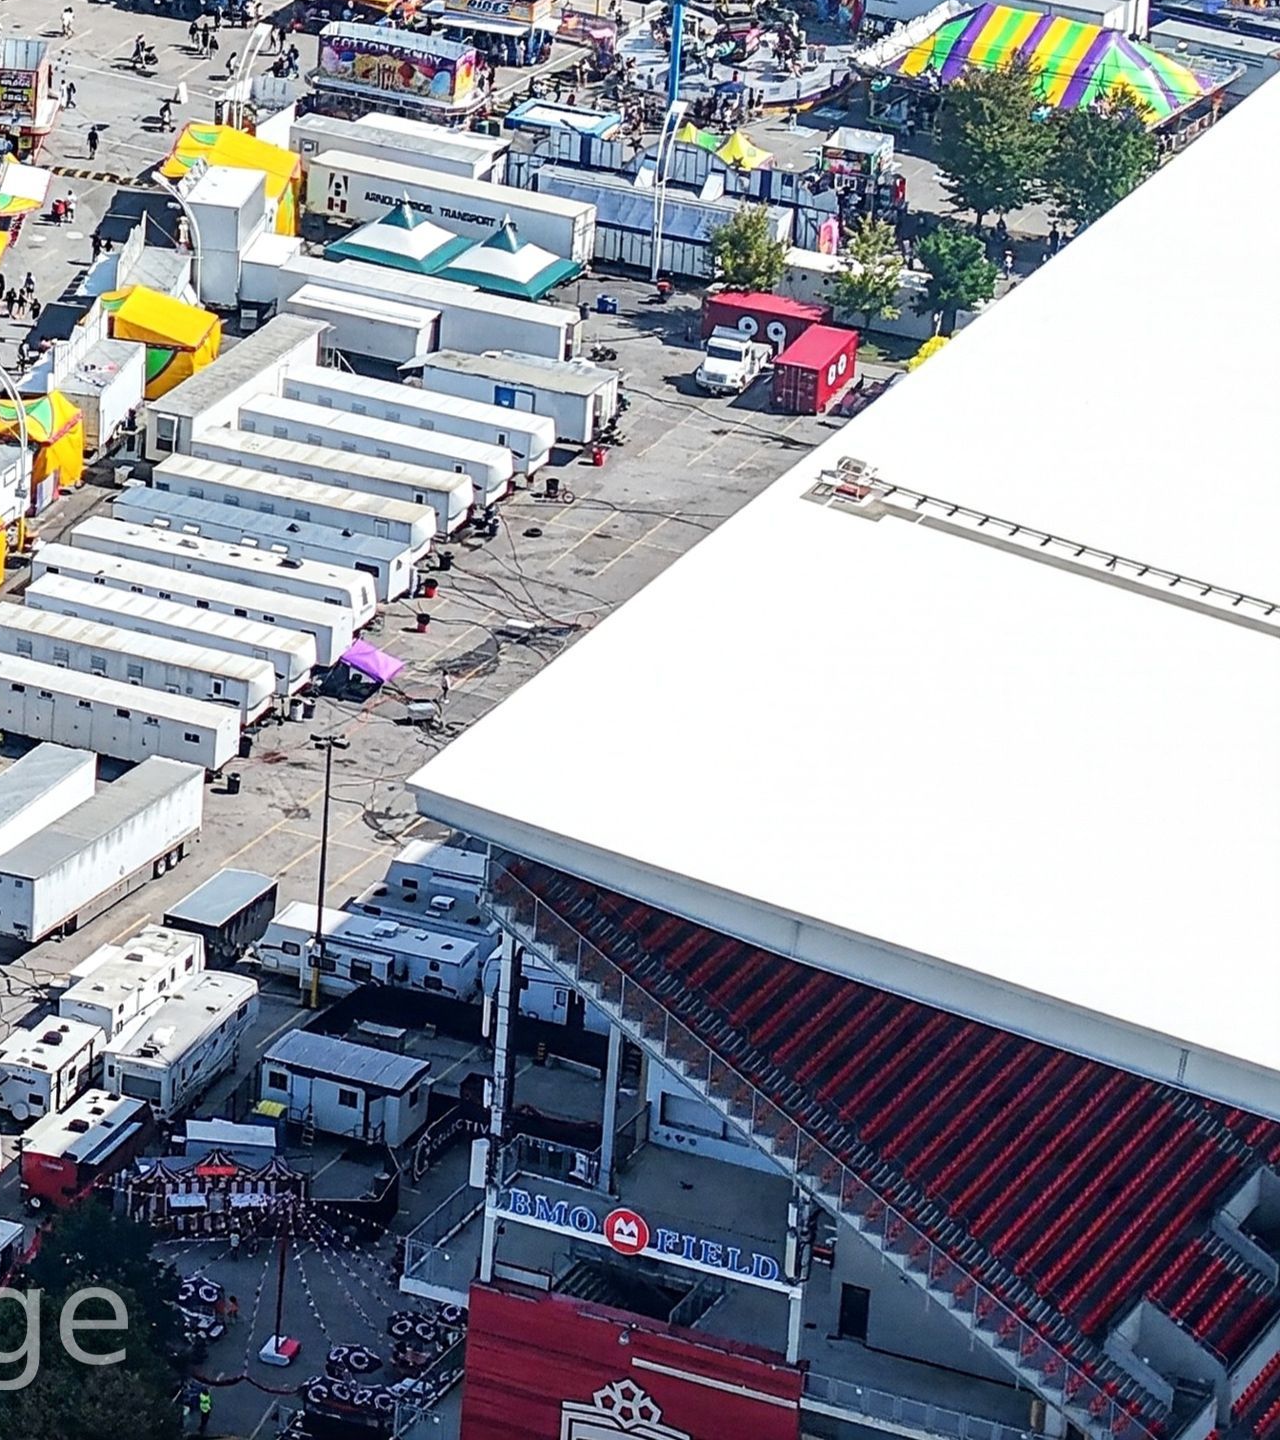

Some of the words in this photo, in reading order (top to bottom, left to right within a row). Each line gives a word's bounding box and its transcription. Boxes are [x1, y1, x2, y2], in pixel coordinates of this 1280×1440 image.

[439, 207, 496, 228] TRANSPORT
[508, 1187, 597, 1233] BMO
[655, 1228, 780, 1283] FIELD
